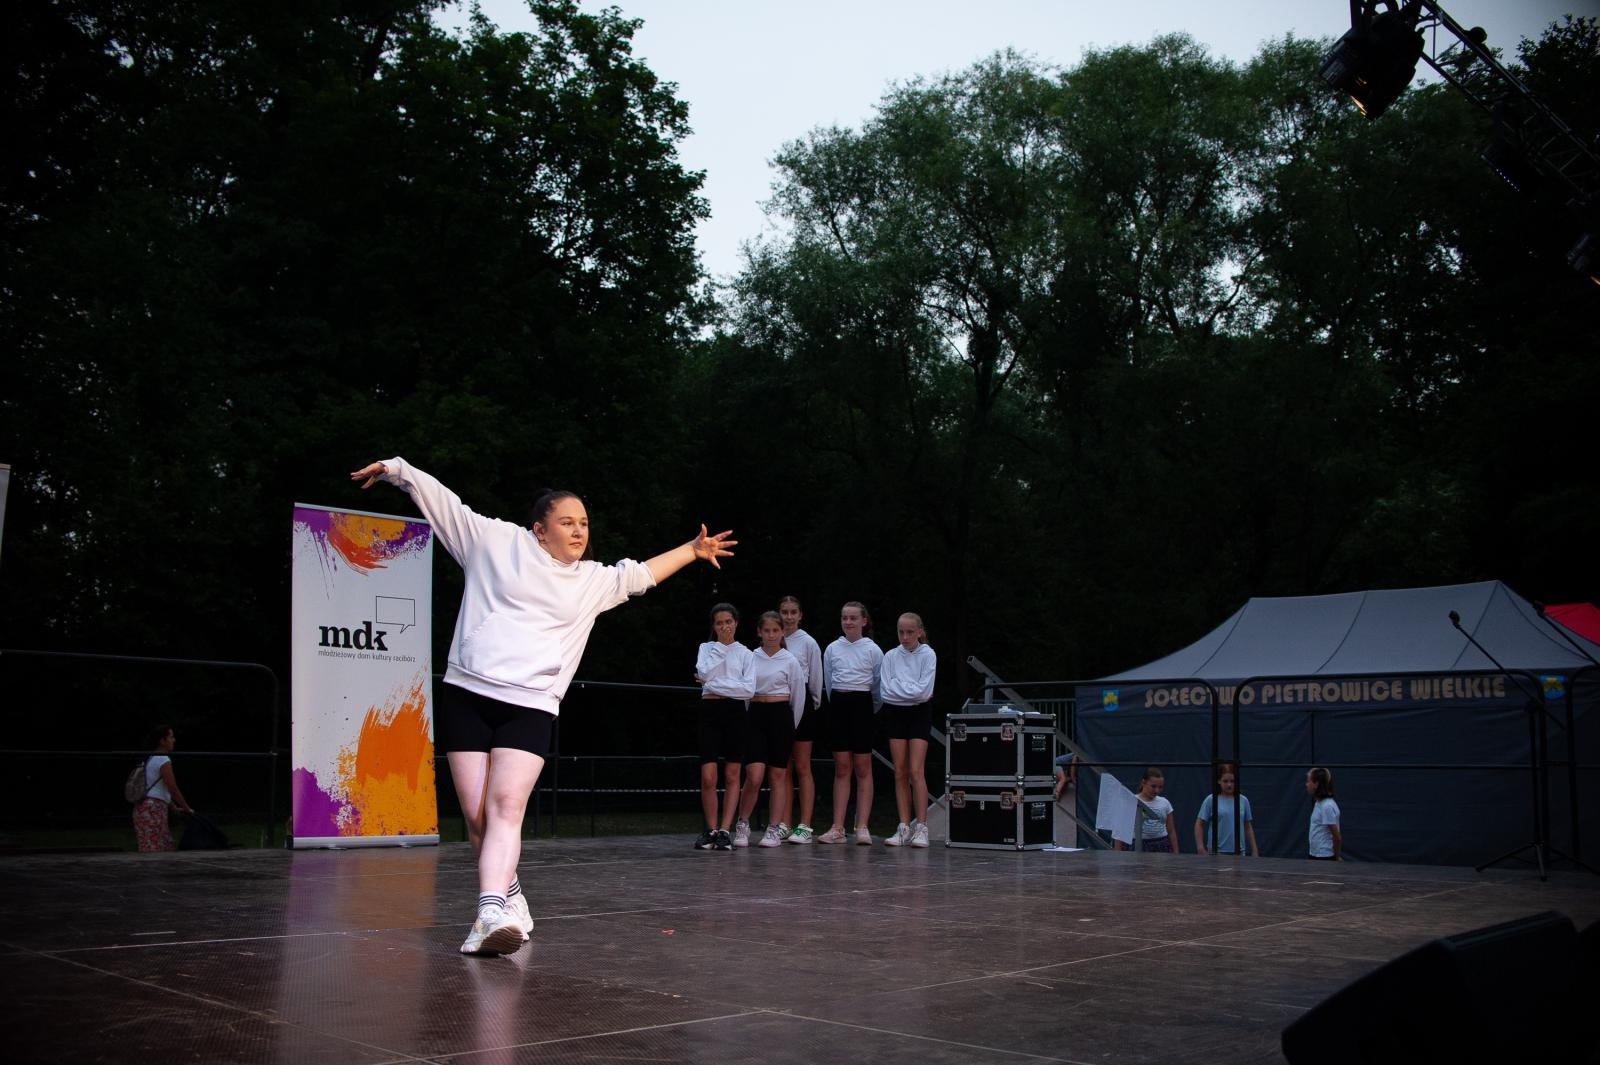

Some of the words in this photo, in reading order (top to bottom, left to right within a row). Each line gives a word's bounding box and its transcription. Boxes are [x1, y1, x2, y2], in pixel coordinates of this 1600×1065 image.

[318, 620, 388, 652] mdk
[357, 651, 371, 660] dom
[372, 652, 392, 662] kultury
[1261, 680, 1403, 705] PIETROWICE
[1410, 677, 1506, 700] WIELKIE
